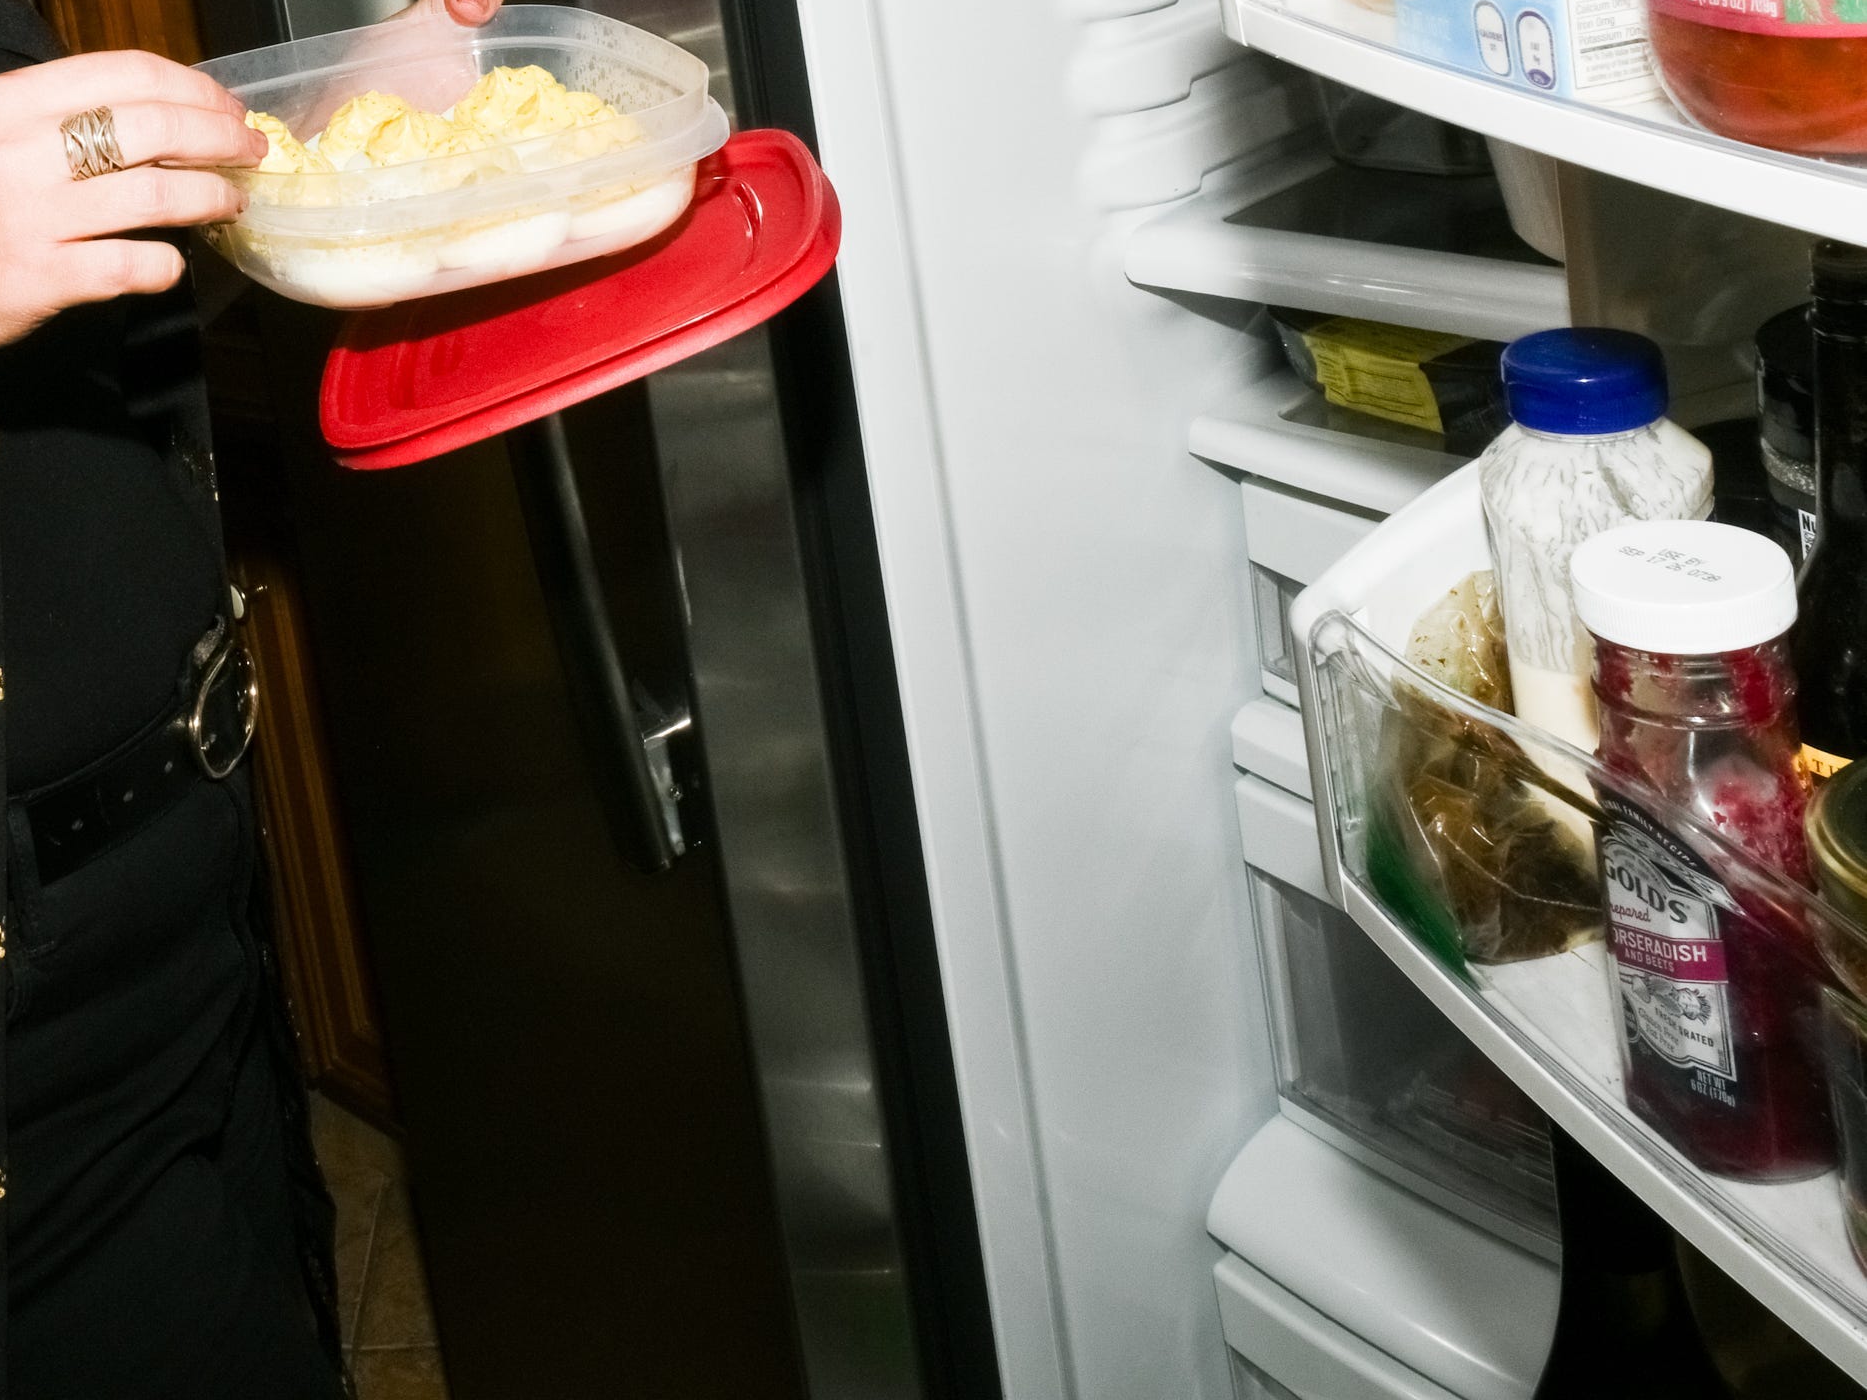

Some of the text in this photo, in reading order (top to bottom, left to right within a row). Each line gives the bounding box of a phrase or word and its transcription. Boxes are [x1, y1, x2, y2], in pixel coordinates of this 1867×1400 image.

[1619, 546, 1645, 557] SEP
[1658, 548, 1710, 566] USE BY
[1622, 805, 1653, 831] FAMILY
[1657, 832, 1698, 867] RECIPE
[1605, 855, 1688, 924] GOLD'S
[1625, 949, 1675, 973] AND BEETS
[1696, 1070, 1726, 1090] NET WT
